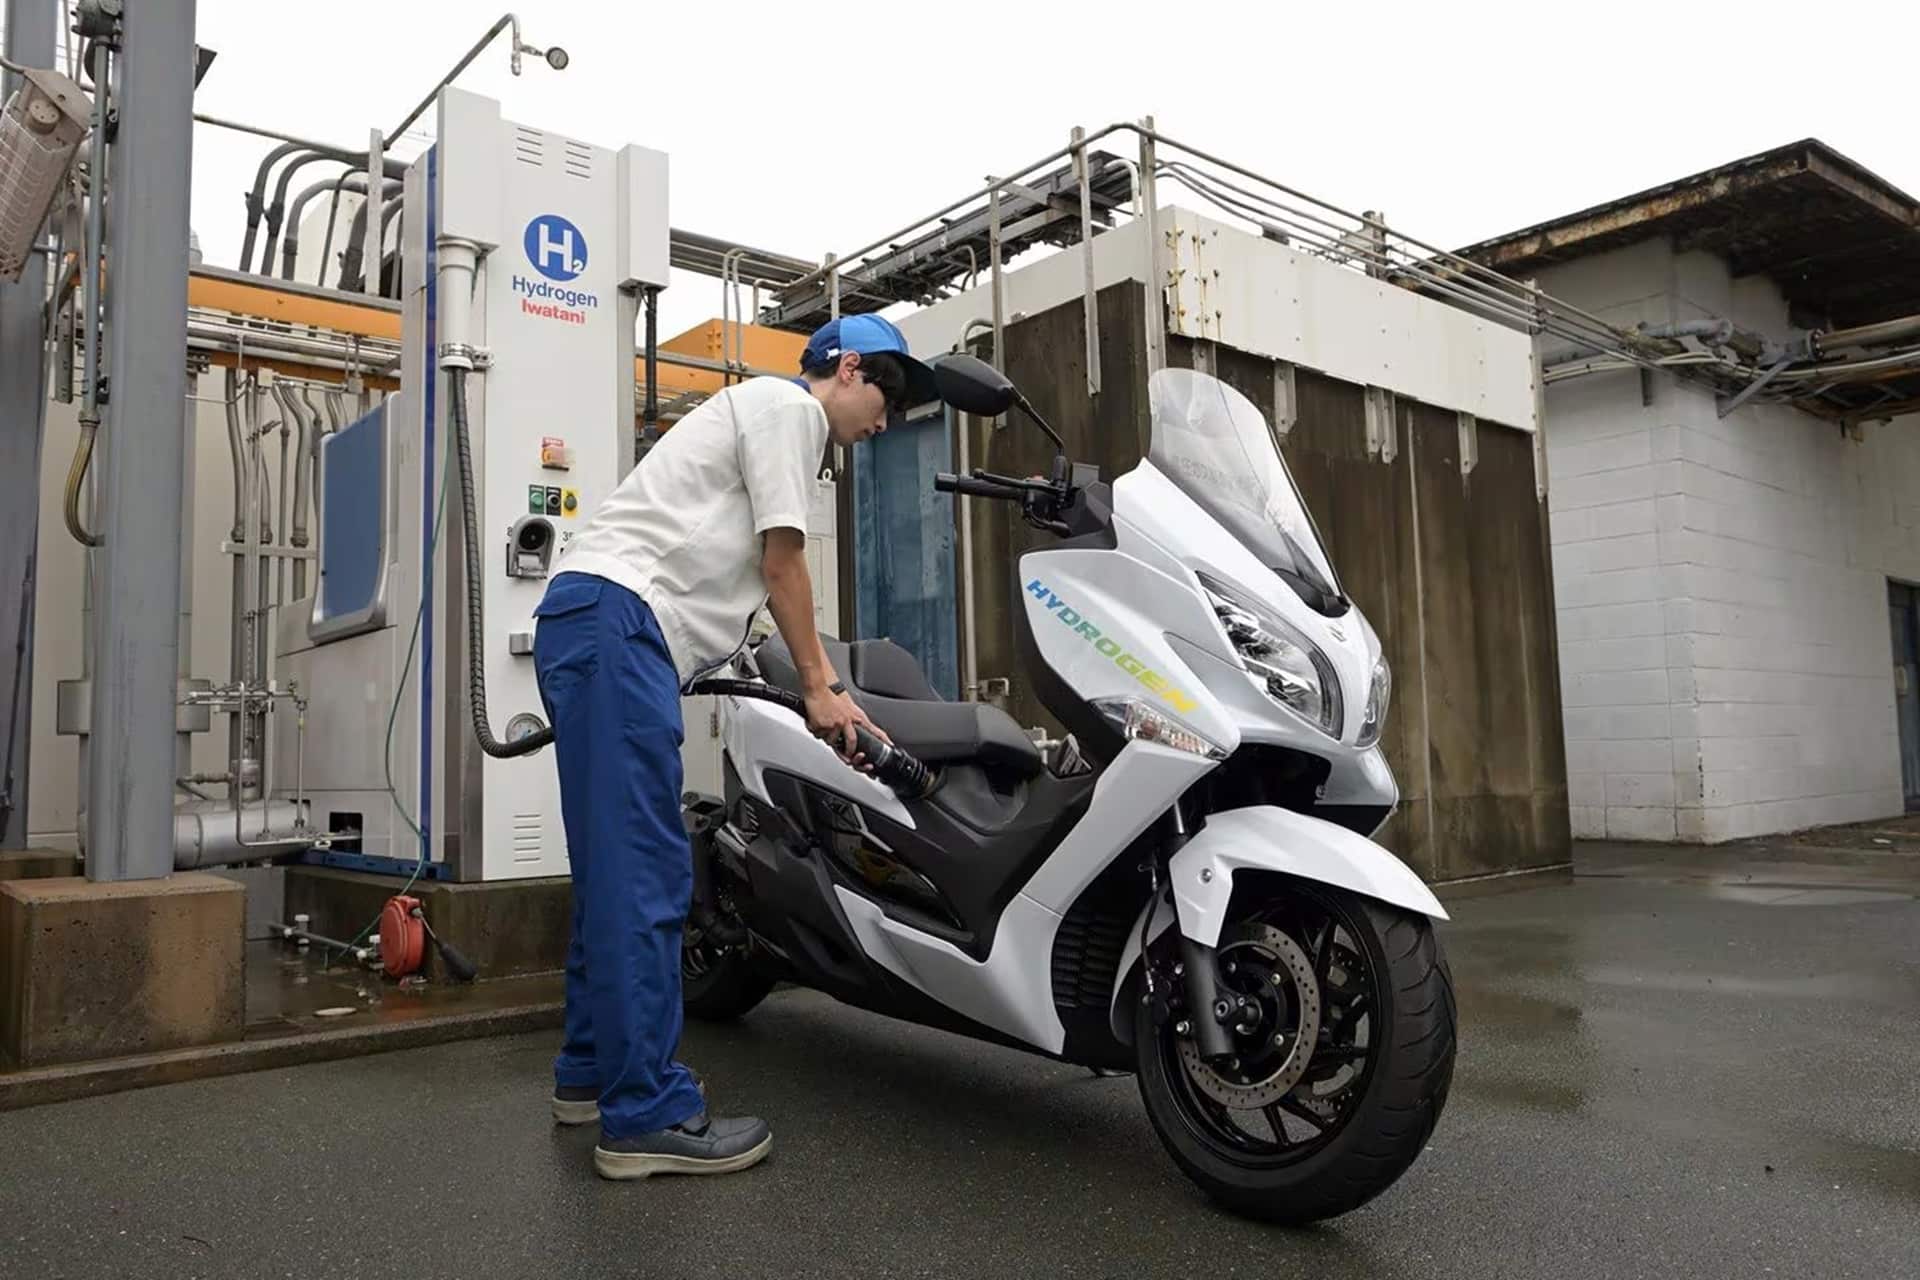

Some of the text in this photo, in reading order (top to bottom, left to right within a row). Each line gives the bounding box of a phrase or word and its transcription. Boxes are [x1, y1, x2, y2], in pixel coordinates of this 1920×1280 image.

[512, 275, 598, 308] Hydrogen
[522, 299, 585, 323] Iwatani
[1027, 580, 1197, 714] HYDROGEN
